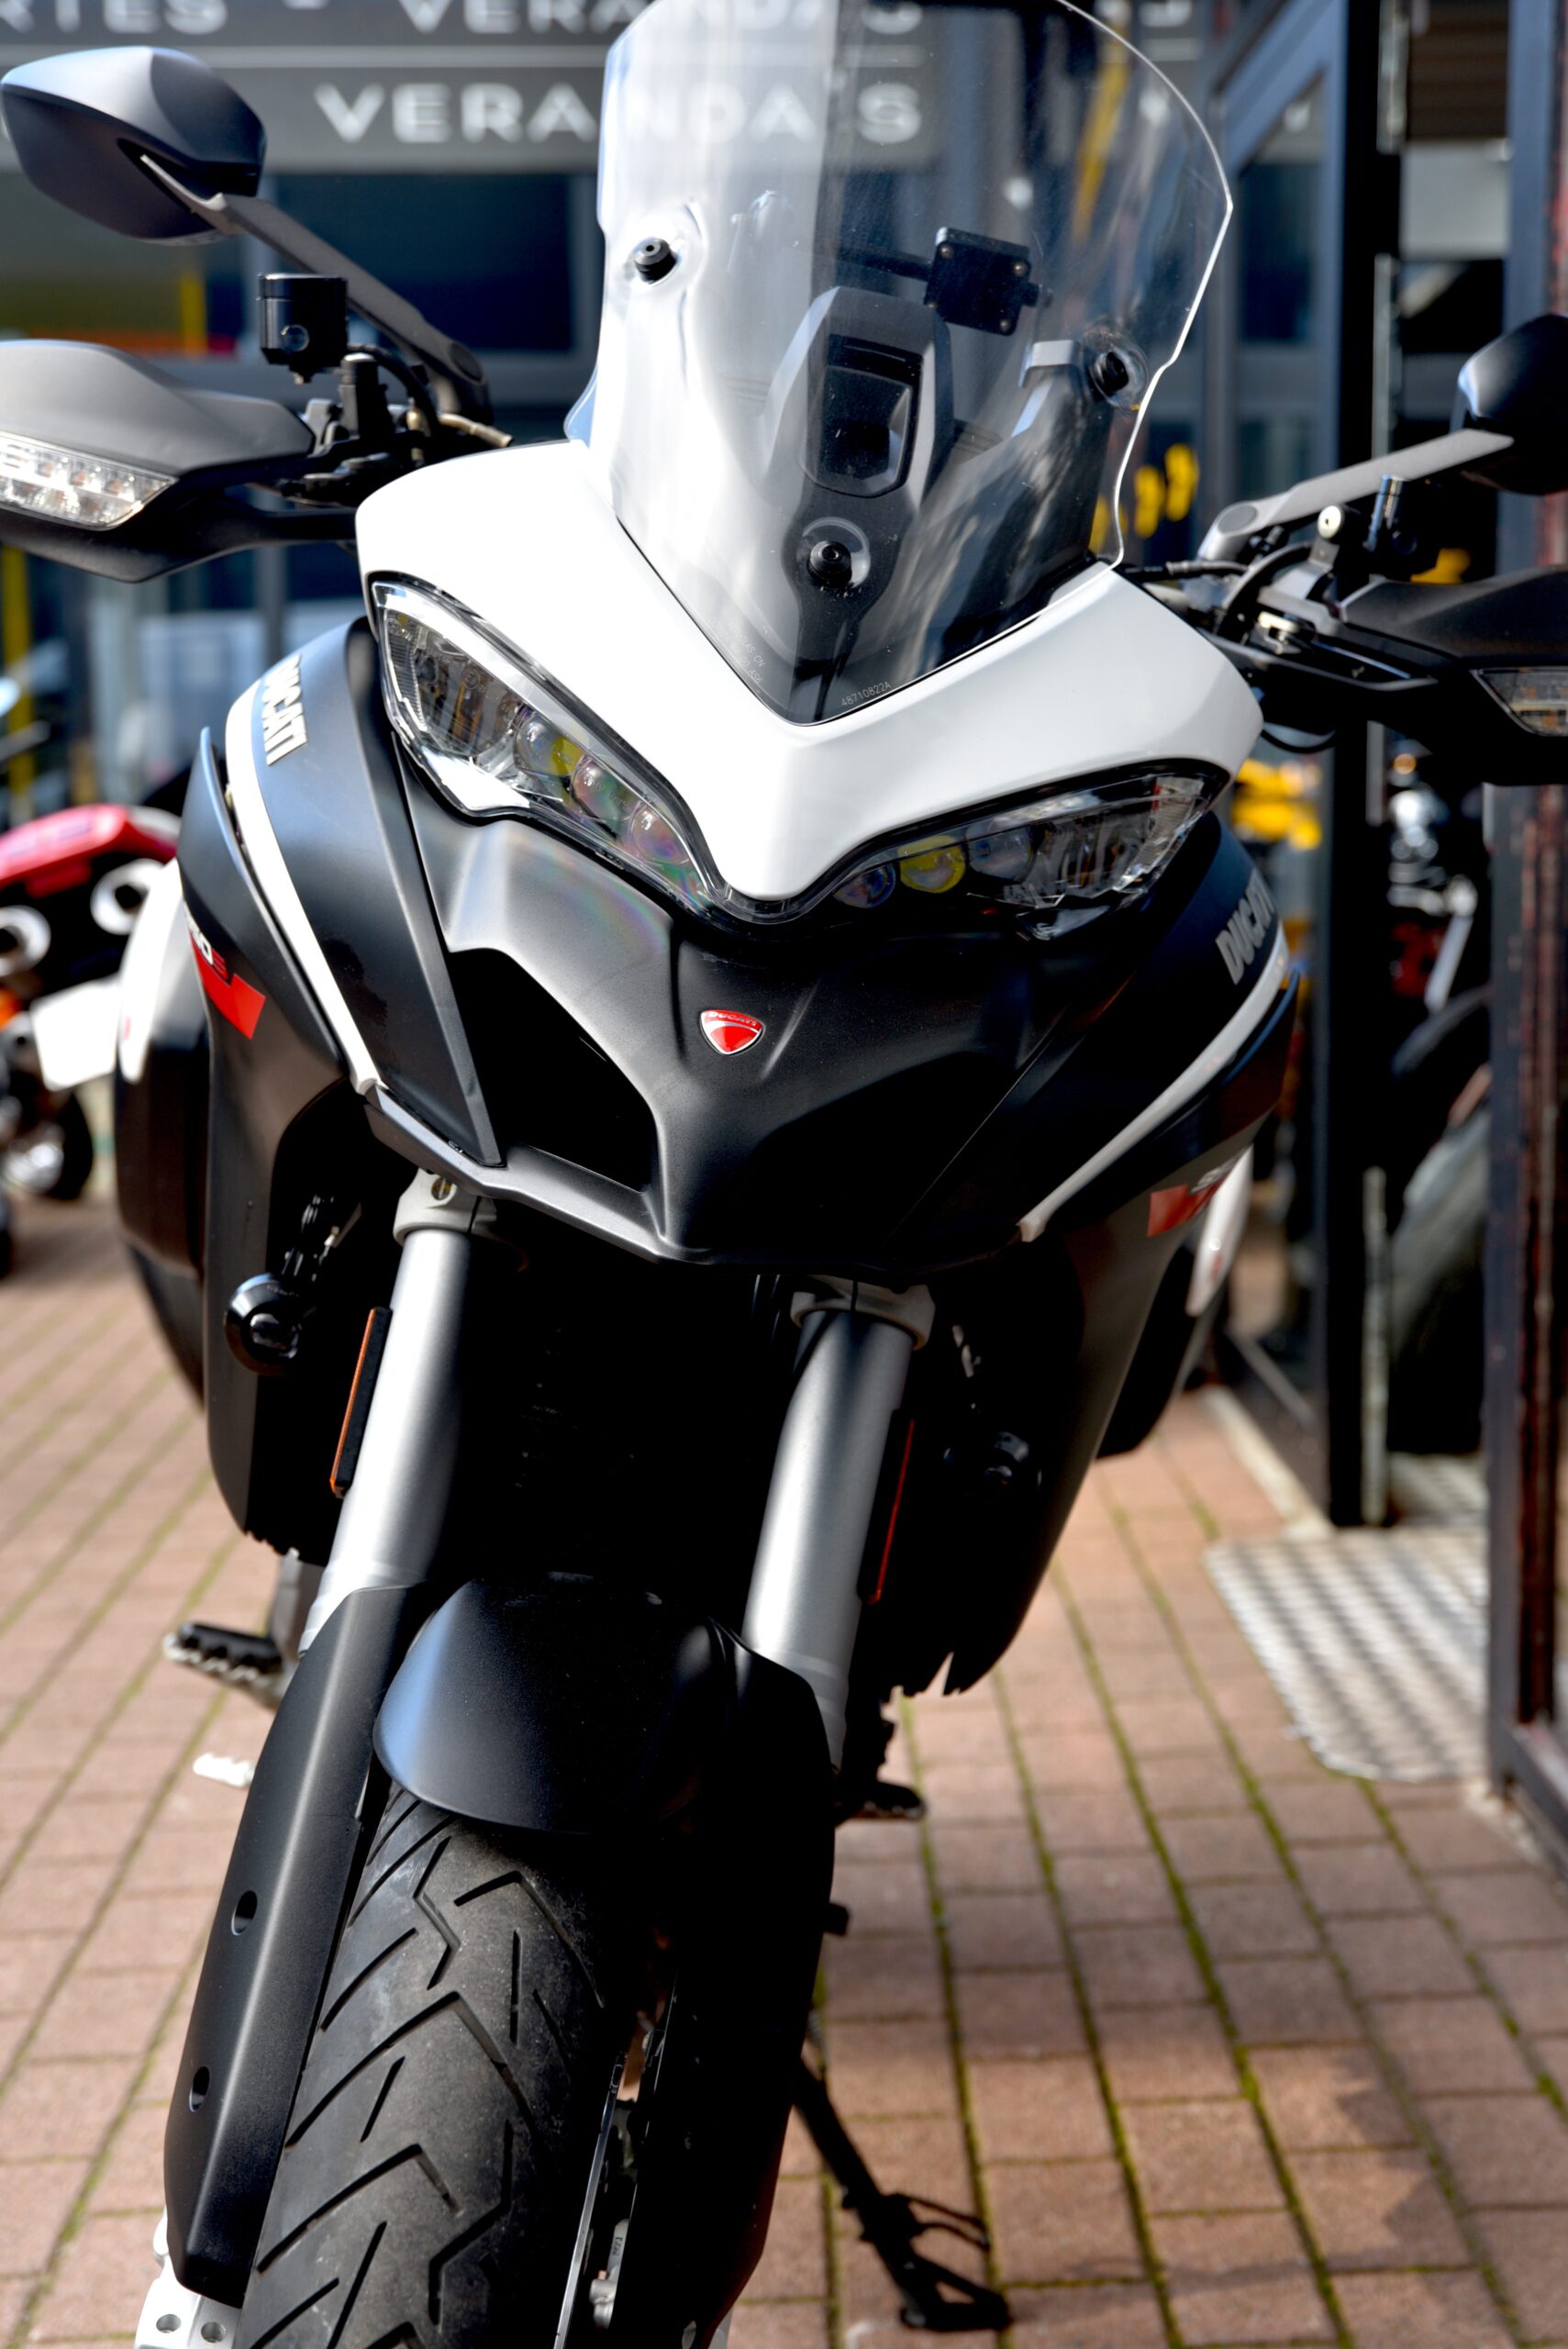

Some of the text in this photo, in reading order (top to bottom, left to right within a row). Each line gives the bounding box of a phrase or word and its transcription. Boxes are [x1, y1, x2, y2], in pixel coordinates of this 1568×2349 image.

[314, 83, 921, 144] VERANDAS
[261, 653, 308, 767] DUCATI
[840, 681, 893, 707] 48710822A
